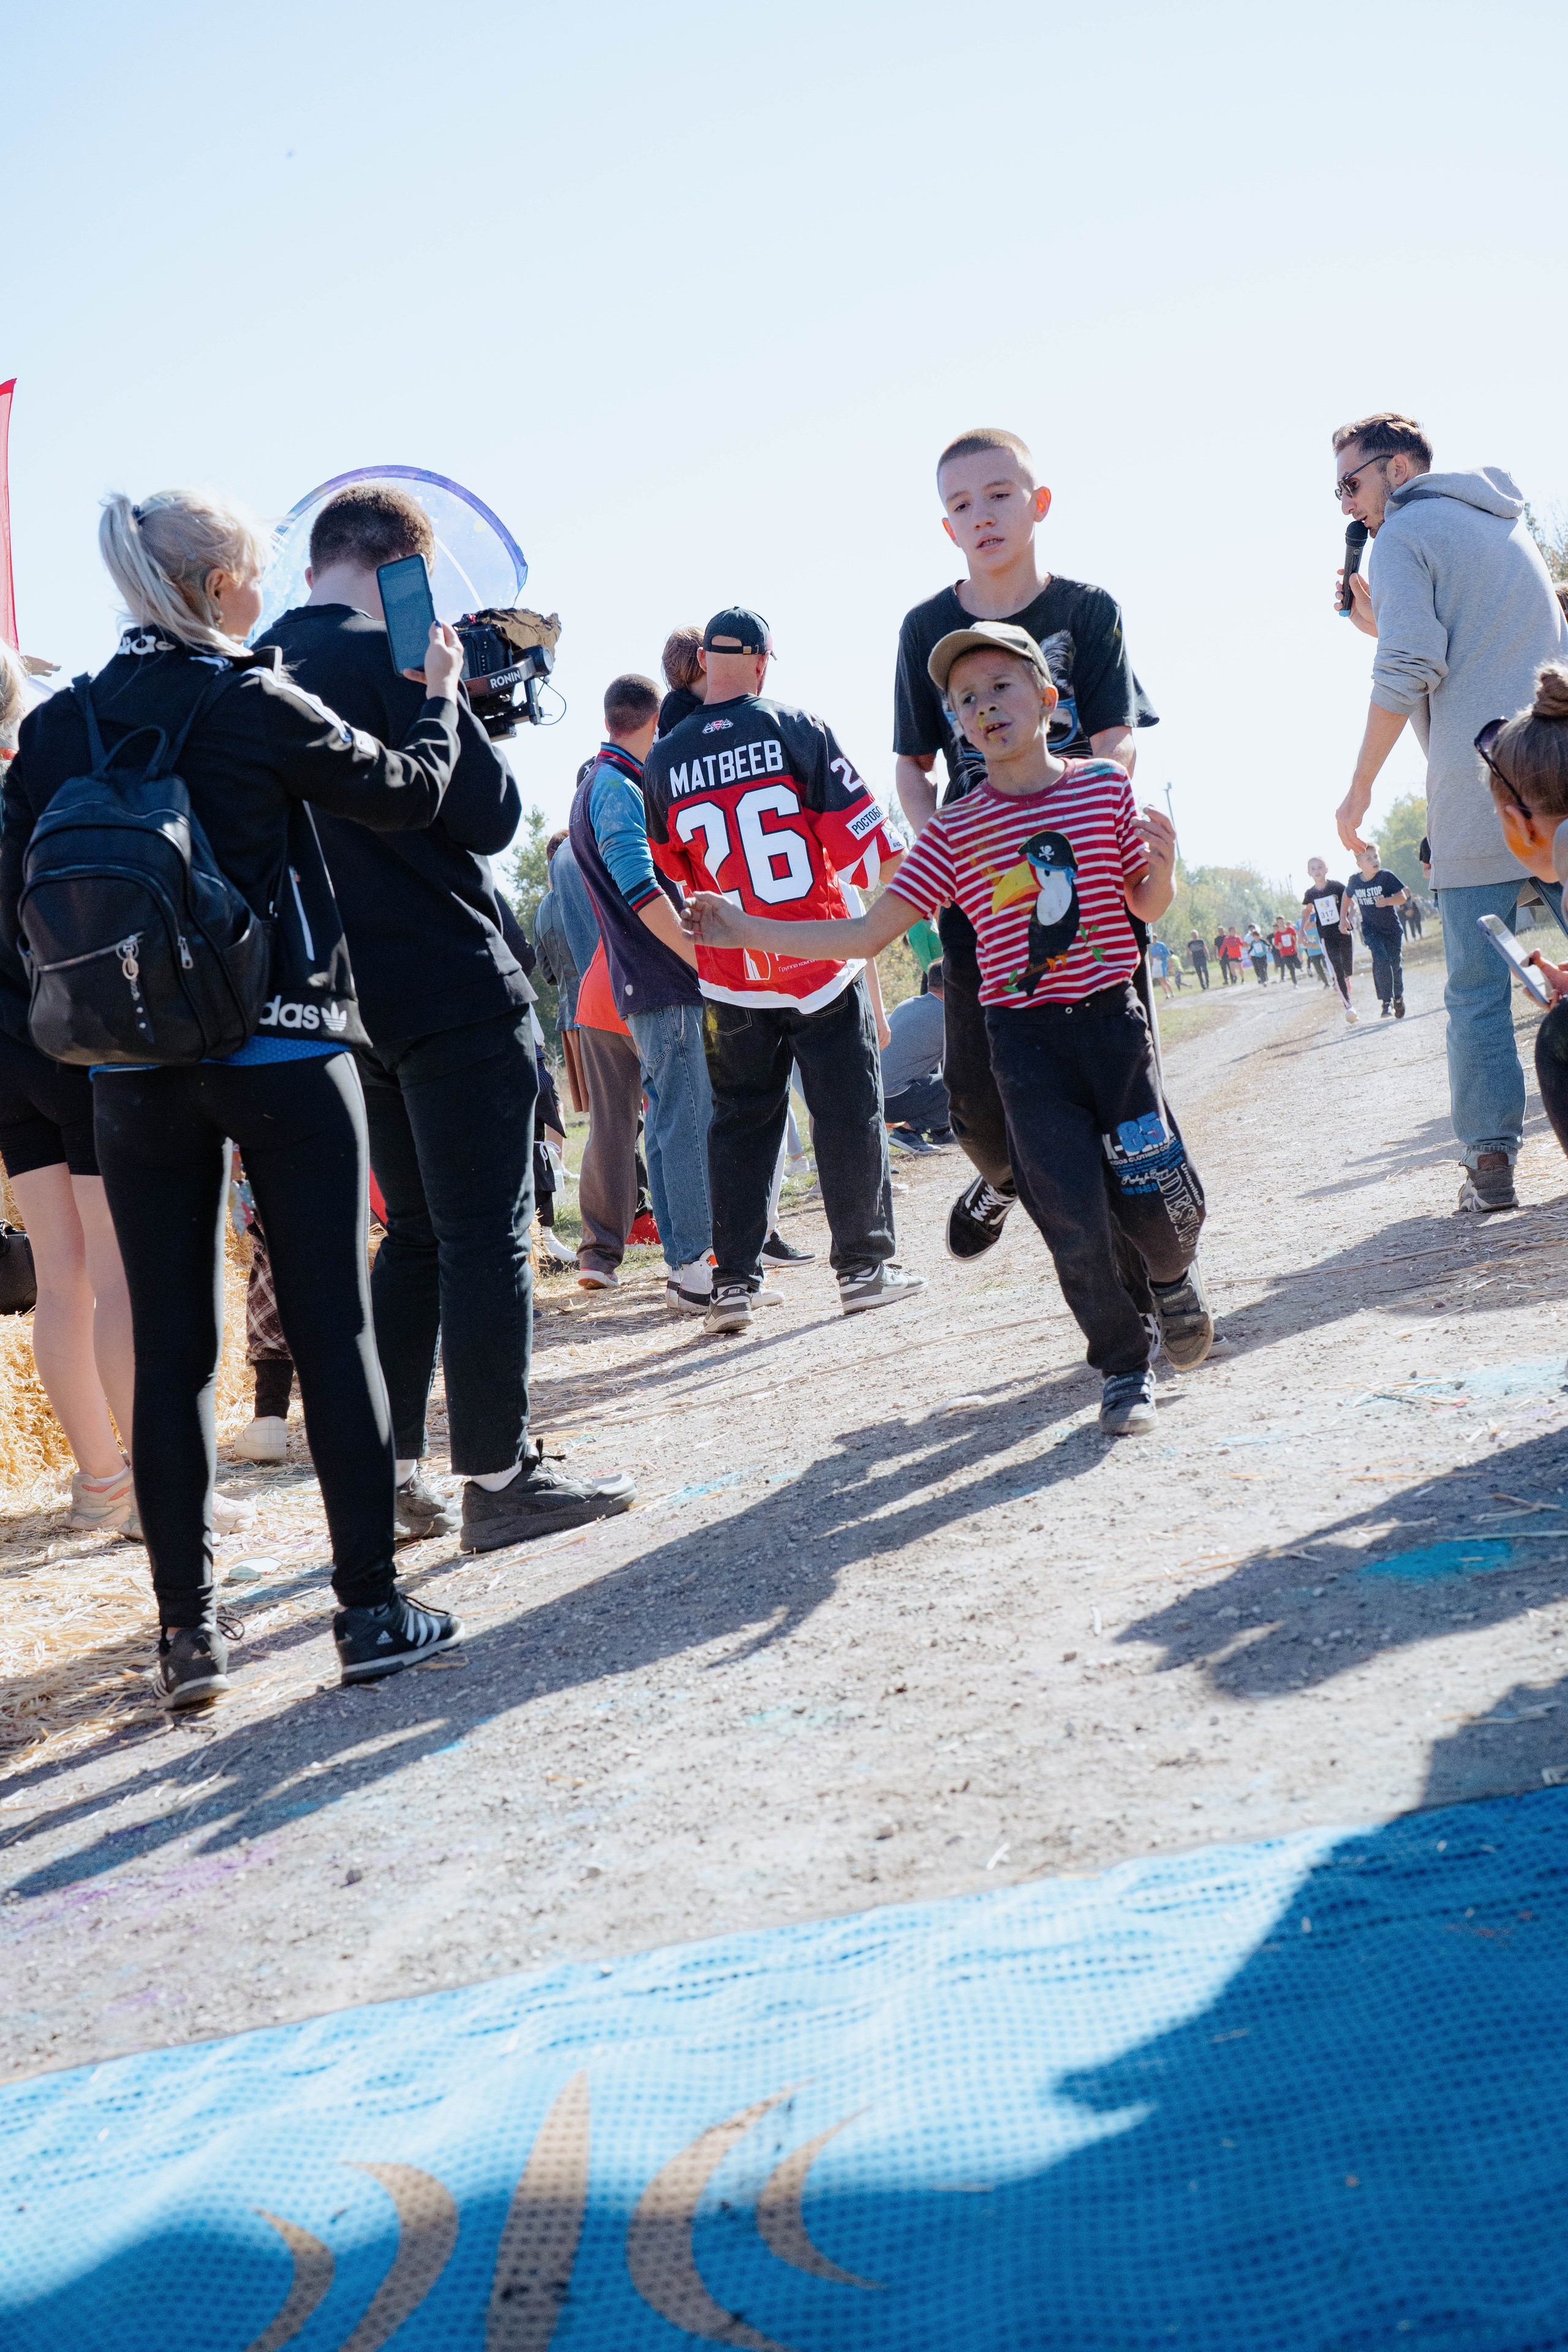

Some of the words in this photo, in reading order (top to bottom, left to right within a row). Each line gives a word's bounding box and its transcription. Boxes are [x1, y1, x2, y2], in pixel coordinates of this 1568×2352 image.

[490, 670, 521, 688] RONIN
[669, 740, 783, 798] МАТВЕЕВ
[676, 783, 815, 912] 26
[1366, 886, 1382, 897] STOP
[1321, 910, 1333, 918] 317
[778, 963, 798, 973] Группа
